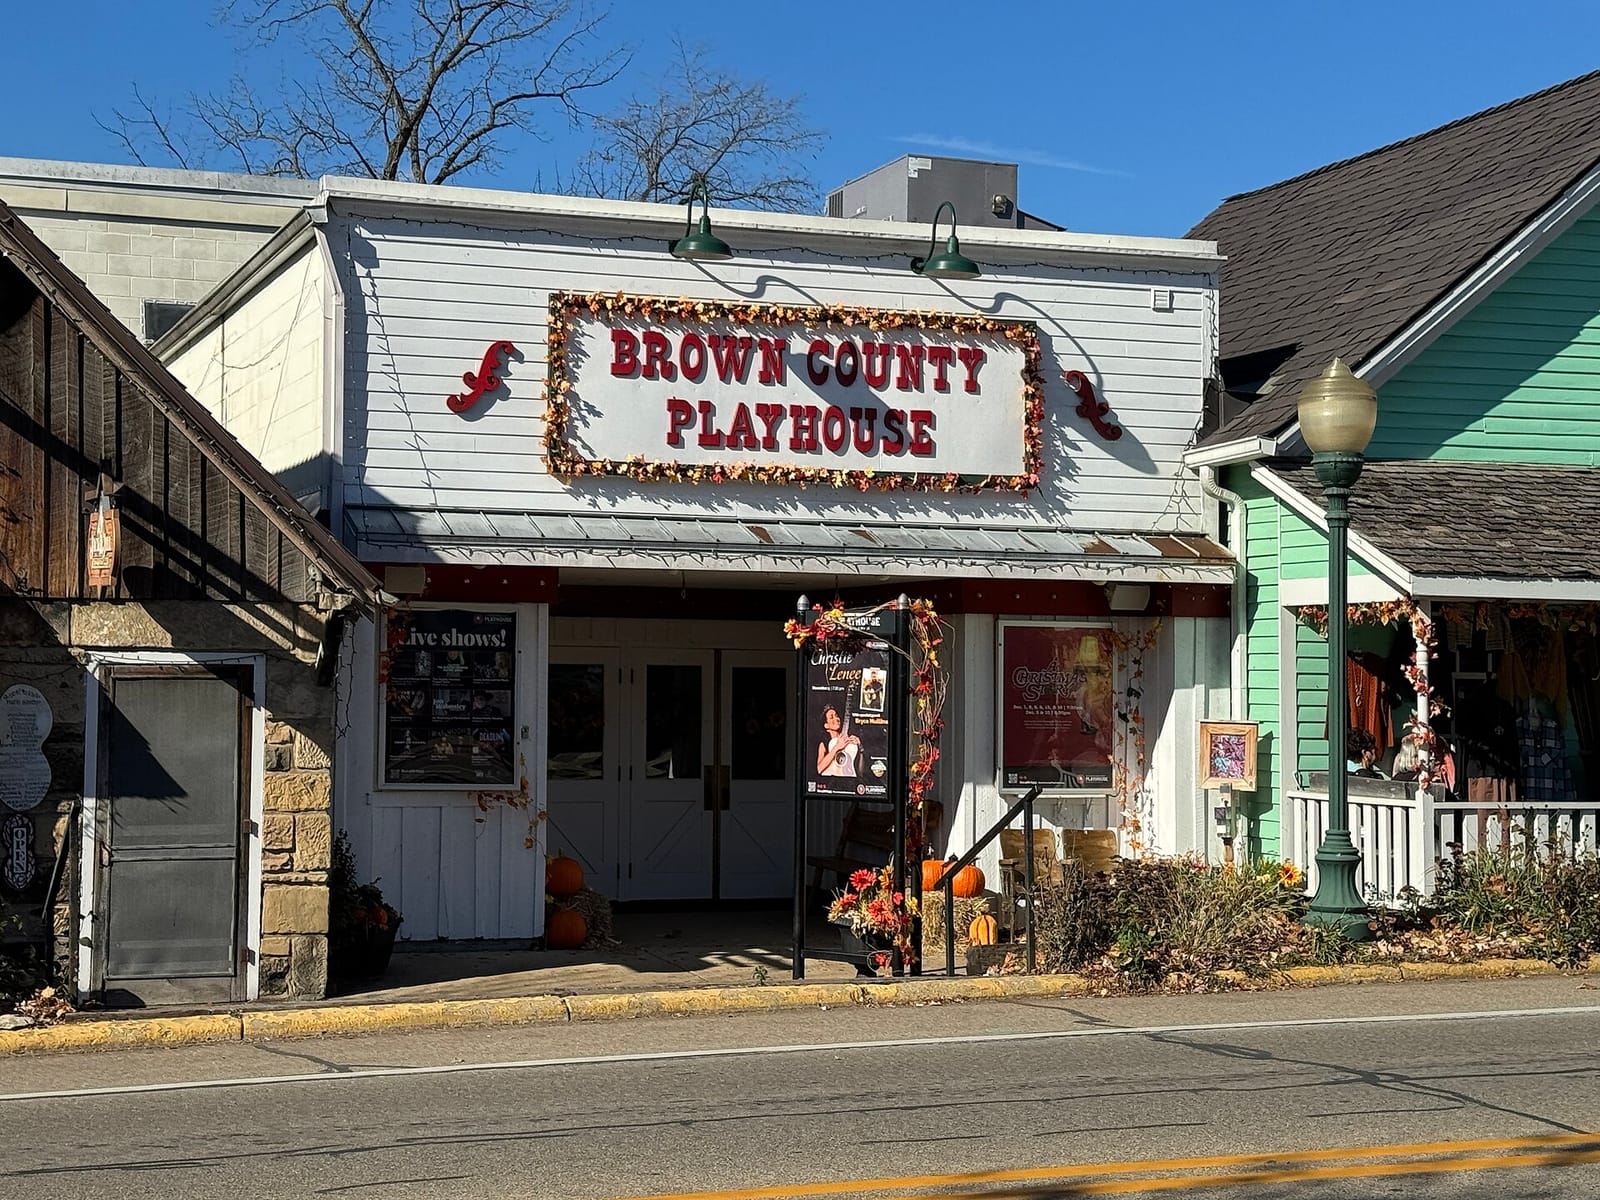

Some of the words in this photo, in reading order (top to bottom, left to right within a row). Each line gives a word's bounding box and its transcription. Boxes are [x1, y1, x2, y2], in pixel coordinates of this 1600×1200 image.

[610, 328, 787, 385] BROWN
[807, 338, 985, 393] COUNTY
[666, 397, 935, 455] PLAYHOUSE
[441, 628, 507, 647] shows!
[811, 648, 852, 665] Christie
[829, 663, 861, 681] Lenee
[14, 829, 25, 872] OPEN
